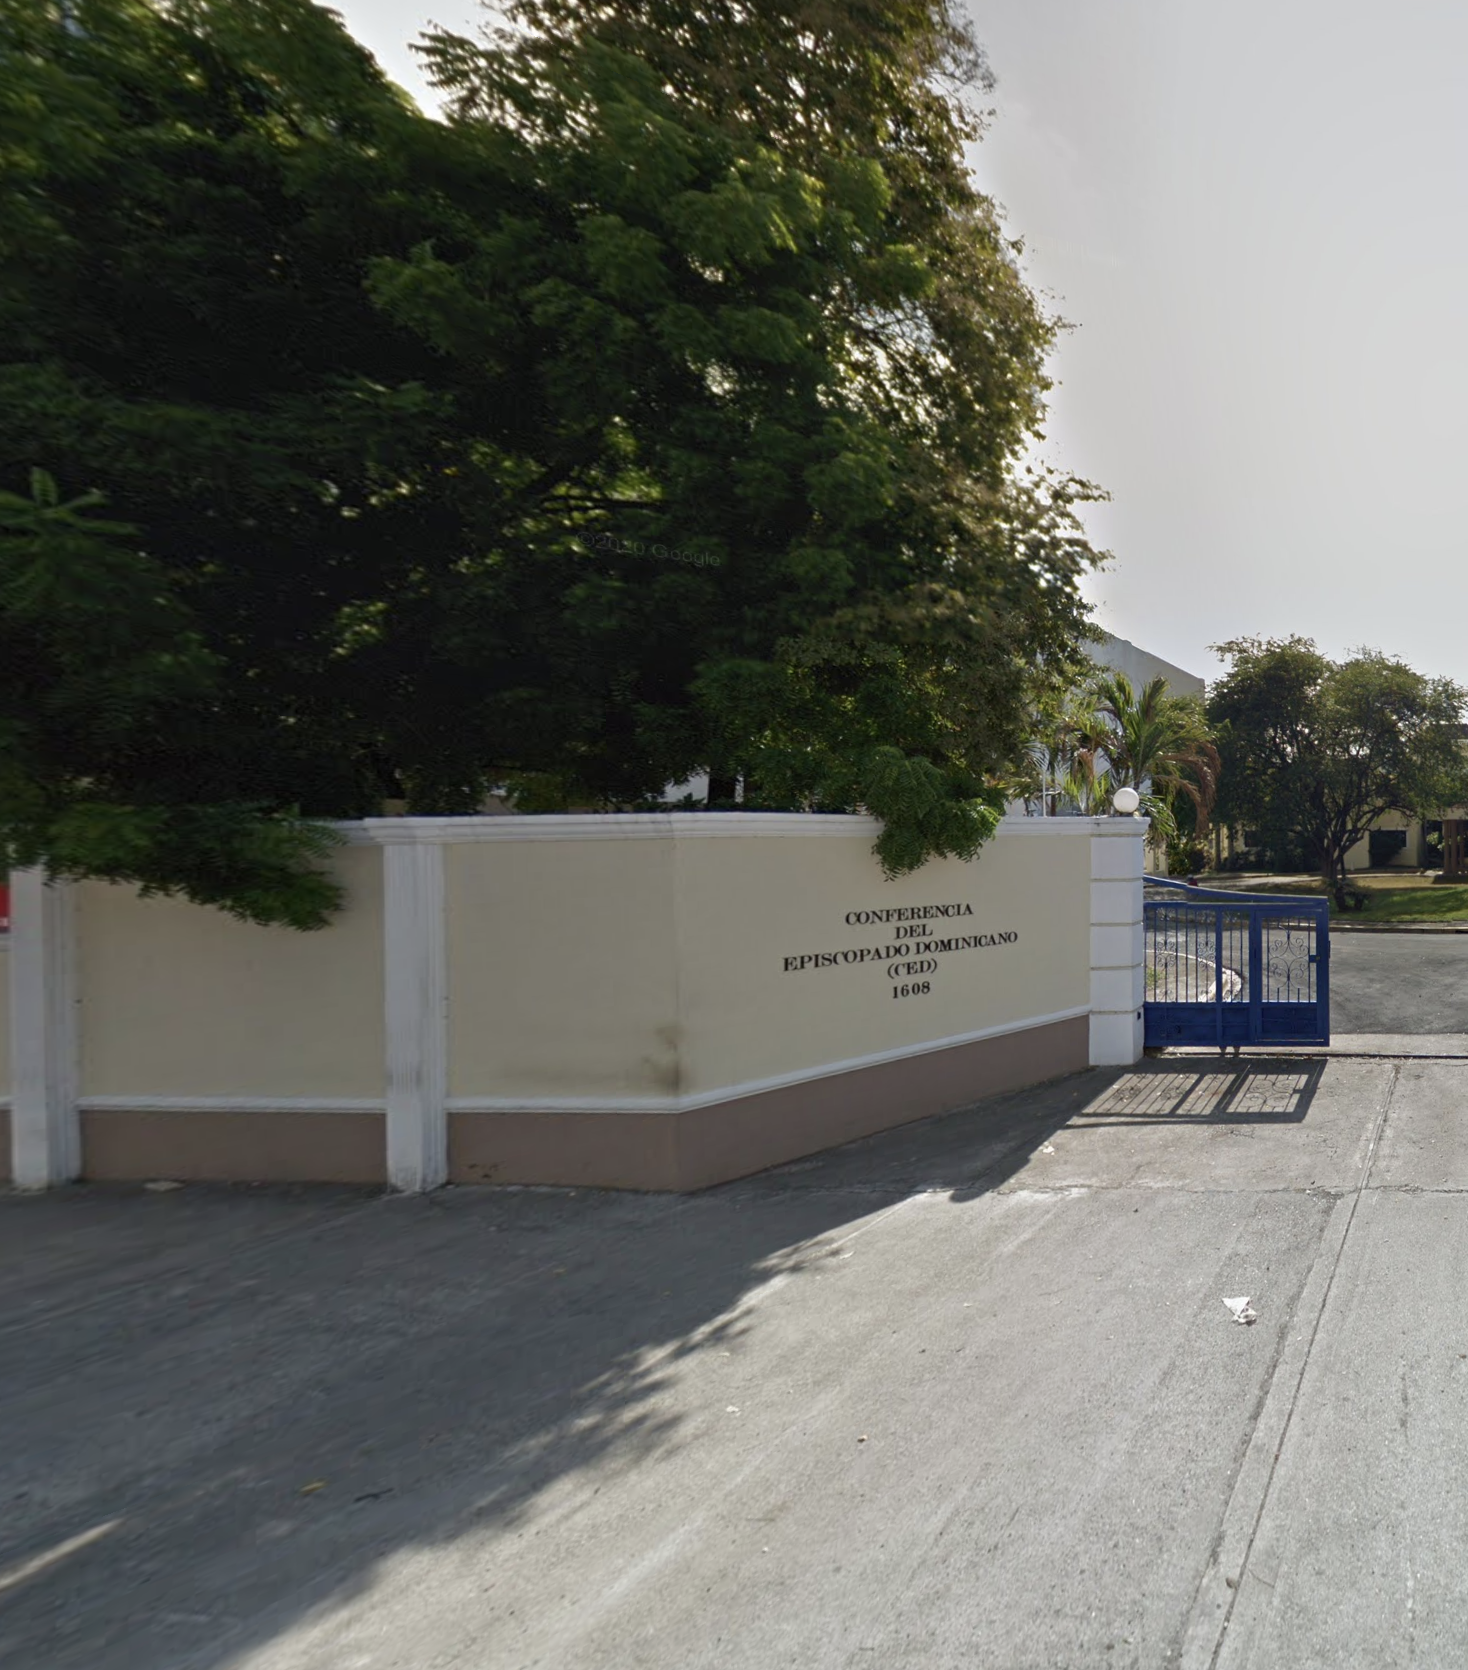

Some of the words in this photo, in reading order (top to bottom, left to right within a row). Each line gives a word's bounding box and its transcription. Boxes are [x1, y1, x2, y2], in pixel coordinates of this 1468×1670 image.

[845, 903, 974, 926] CONFERENCIA
[894, 923, 933, 939] DEL
[782, 943, 910, 972] EPISCOPADO
[914, 931, 1018, 955] DOMINICANO
[887, 958, 938, 979] (CED)
[892, 981, 931, 999] 1608
